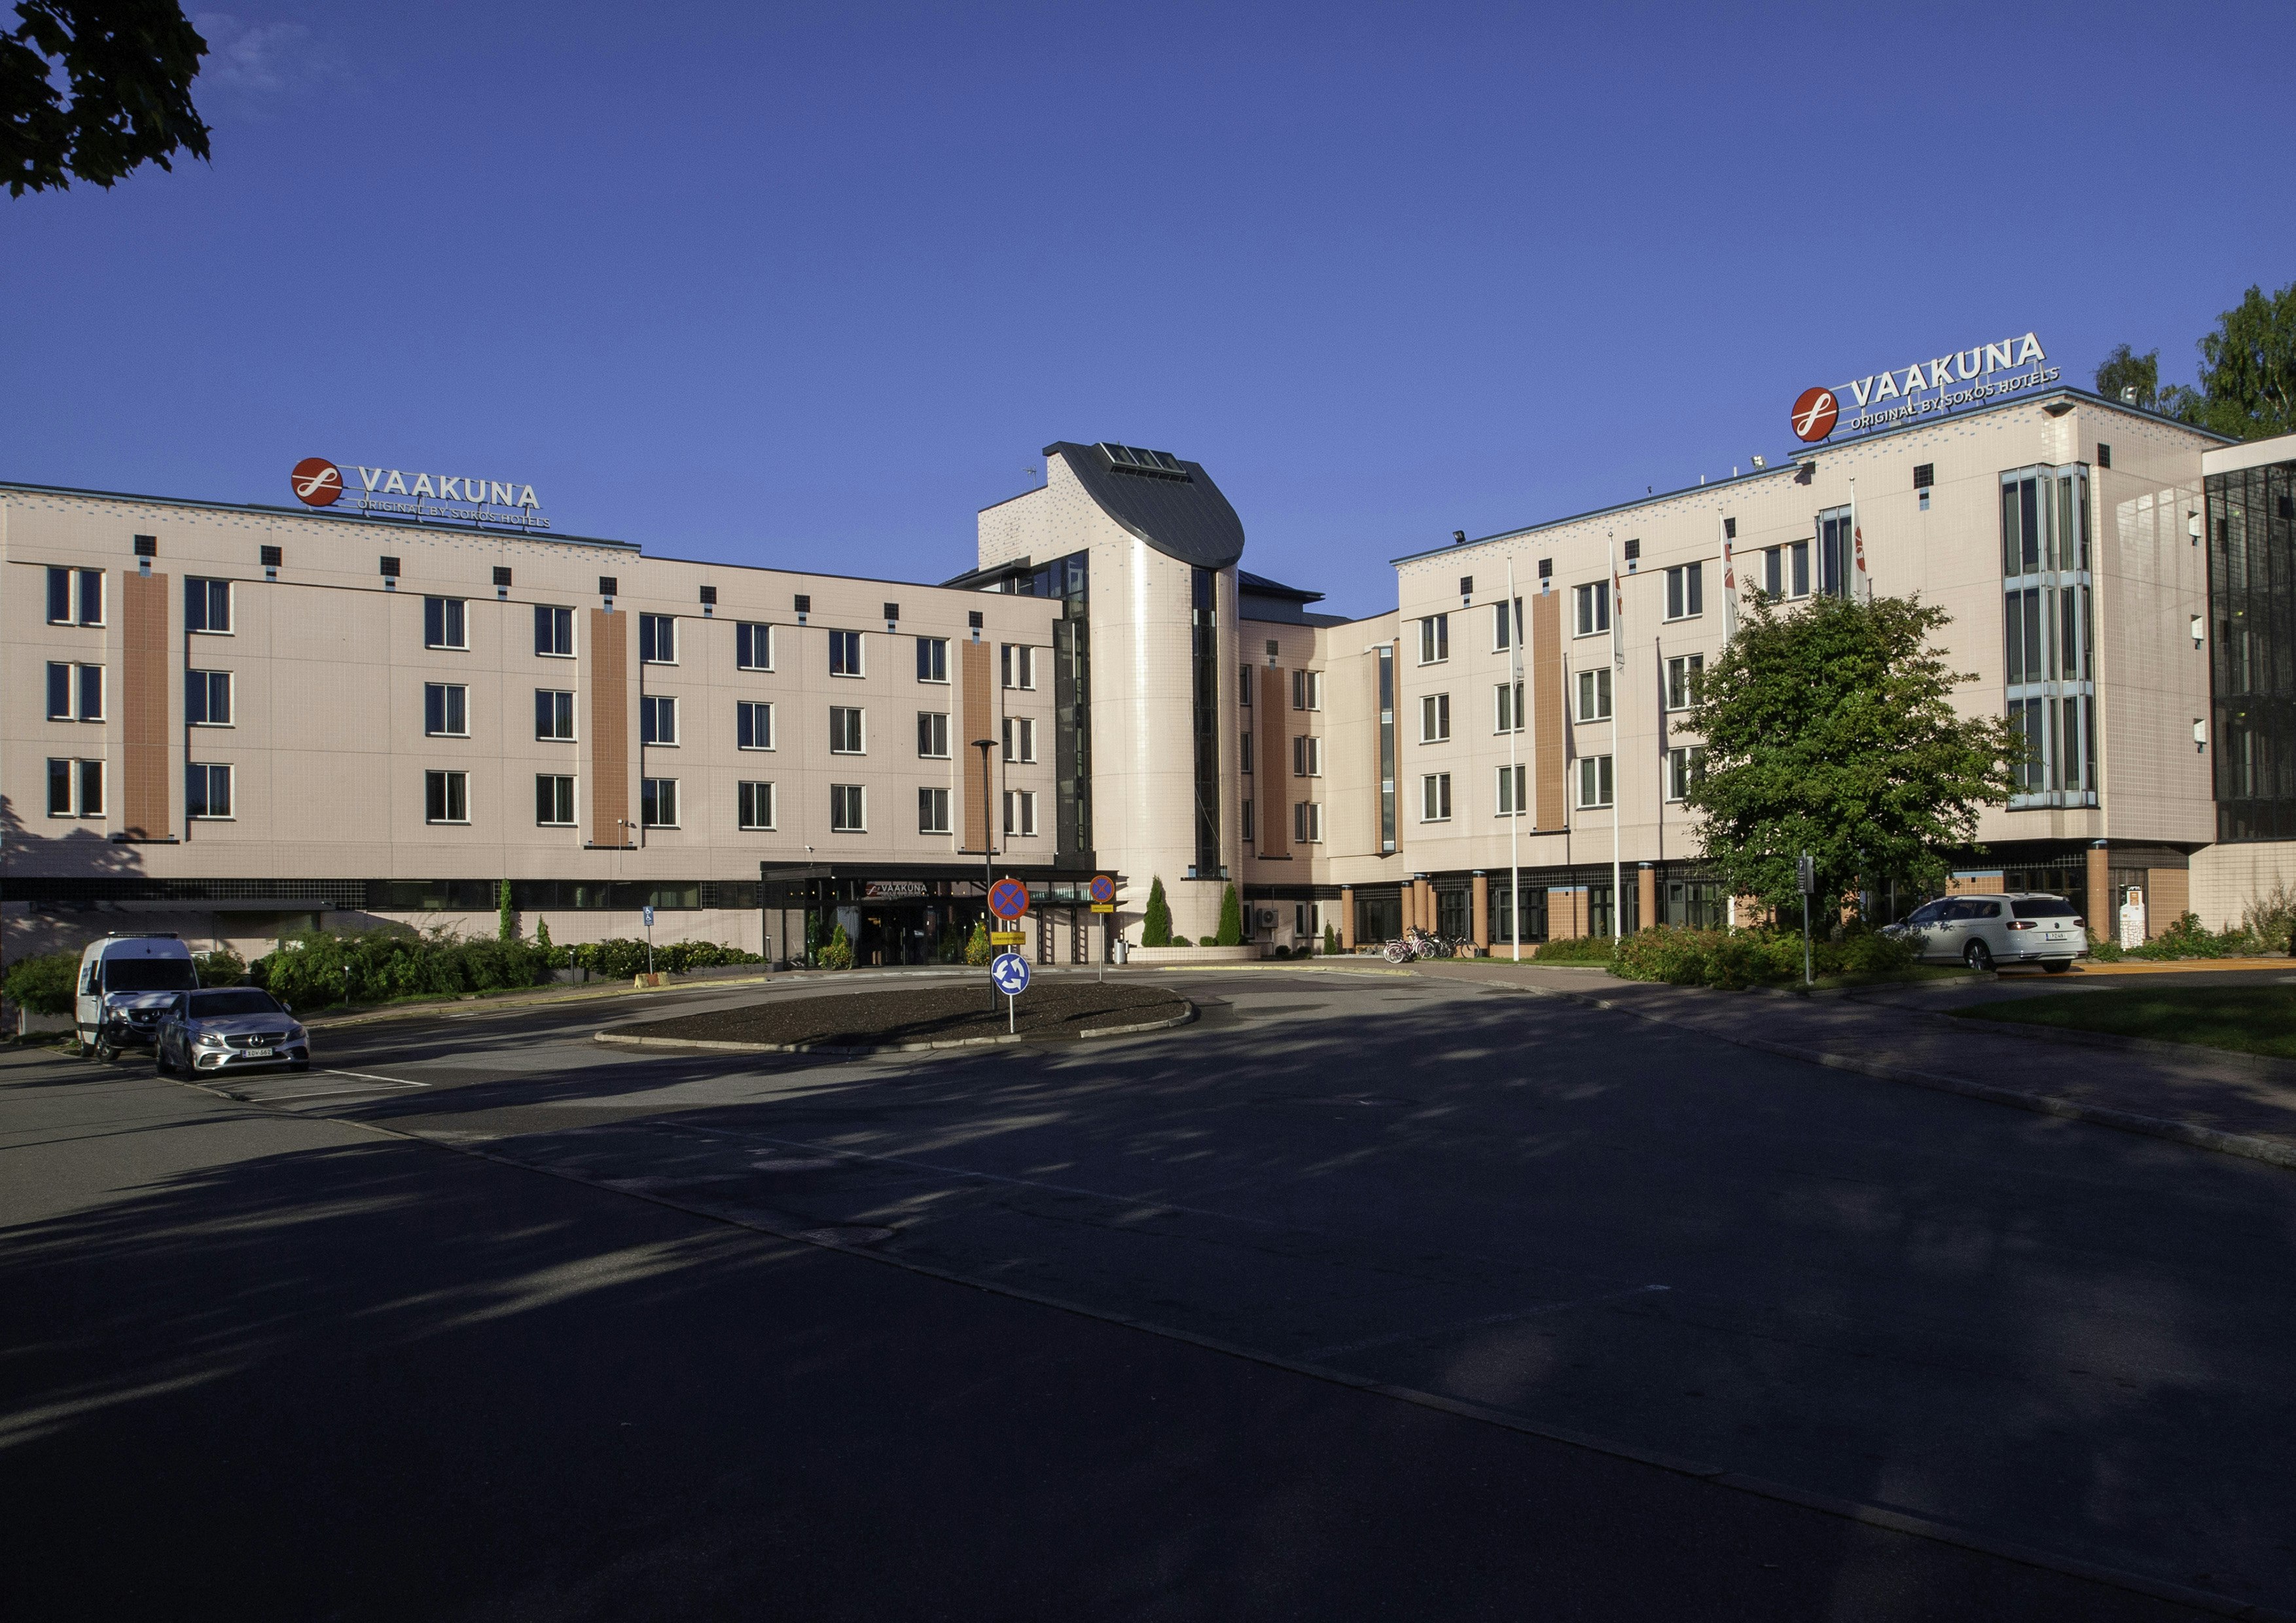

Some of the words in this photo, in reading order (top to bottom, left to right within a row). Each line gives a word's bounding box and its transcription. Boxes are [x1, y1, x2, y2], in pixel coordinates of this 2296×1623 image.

[1850, 331, 2047, 408] VAAKUNA
[1850, 405, 1918, 431] ORIGINAL
[1922, 395, 1942, 413] BY
[1945, 383, 1995, 406] SOKOS
[1999, 367, 2061, 393] HOTELS
[357, 499, 423, 515] ORIGINAL
[429, 506, 446, 518] BY
[452, 510, 496, 523] SOKOS
[500, 514, 551, 527] HOTELS
[358, 466, 541, 510] VAAKUNA
